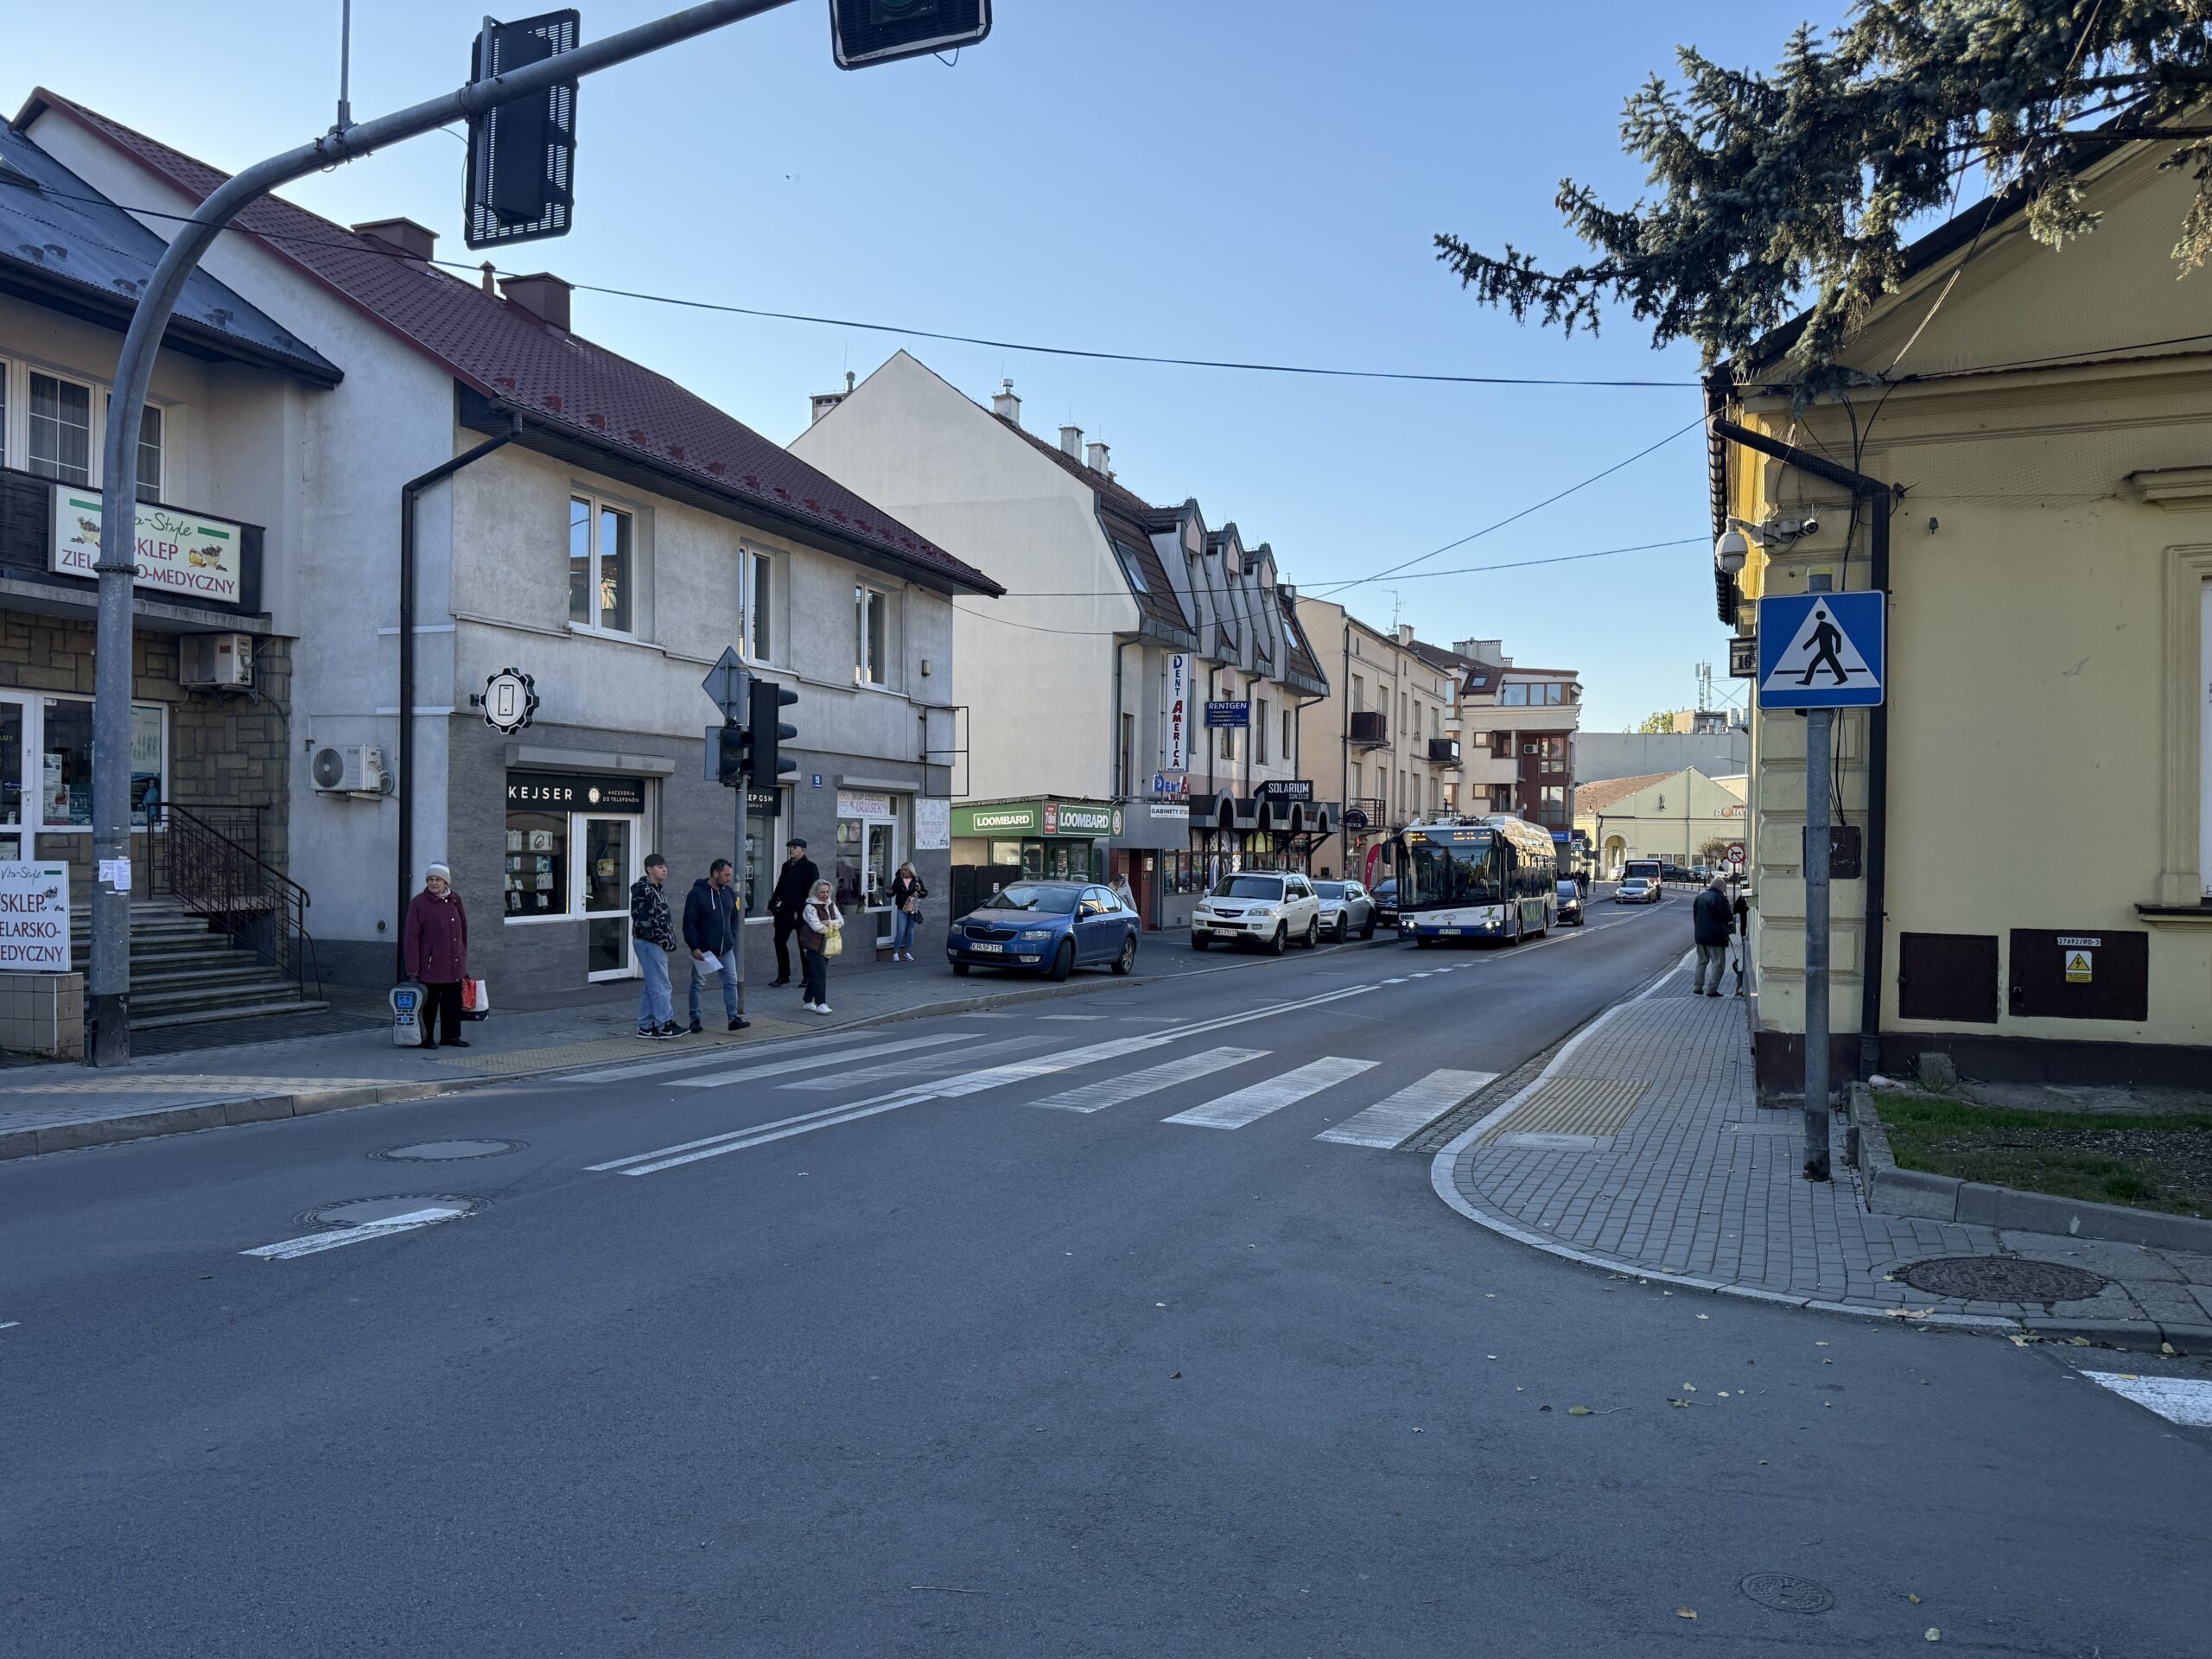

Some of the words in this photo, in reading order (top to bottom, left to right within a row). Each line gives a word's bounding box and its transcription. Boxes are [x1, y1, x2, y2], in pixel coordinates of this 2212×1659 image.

[133, 537, 179, 561] KLEP
[61, 549, 235, 594] ZIELO-MEDYCZNY
[1172, 701, 1183, 766] AMERICA
[508, 785, 573, 800] KEJSER
[1268, 783, 1309, 793] SOLARIUM
[976, 815, 1030, 826] LOOMBARD
[1059, 812, 1109, 829] LOOMBARD
[0, 893, 45, 913] SKLEP
